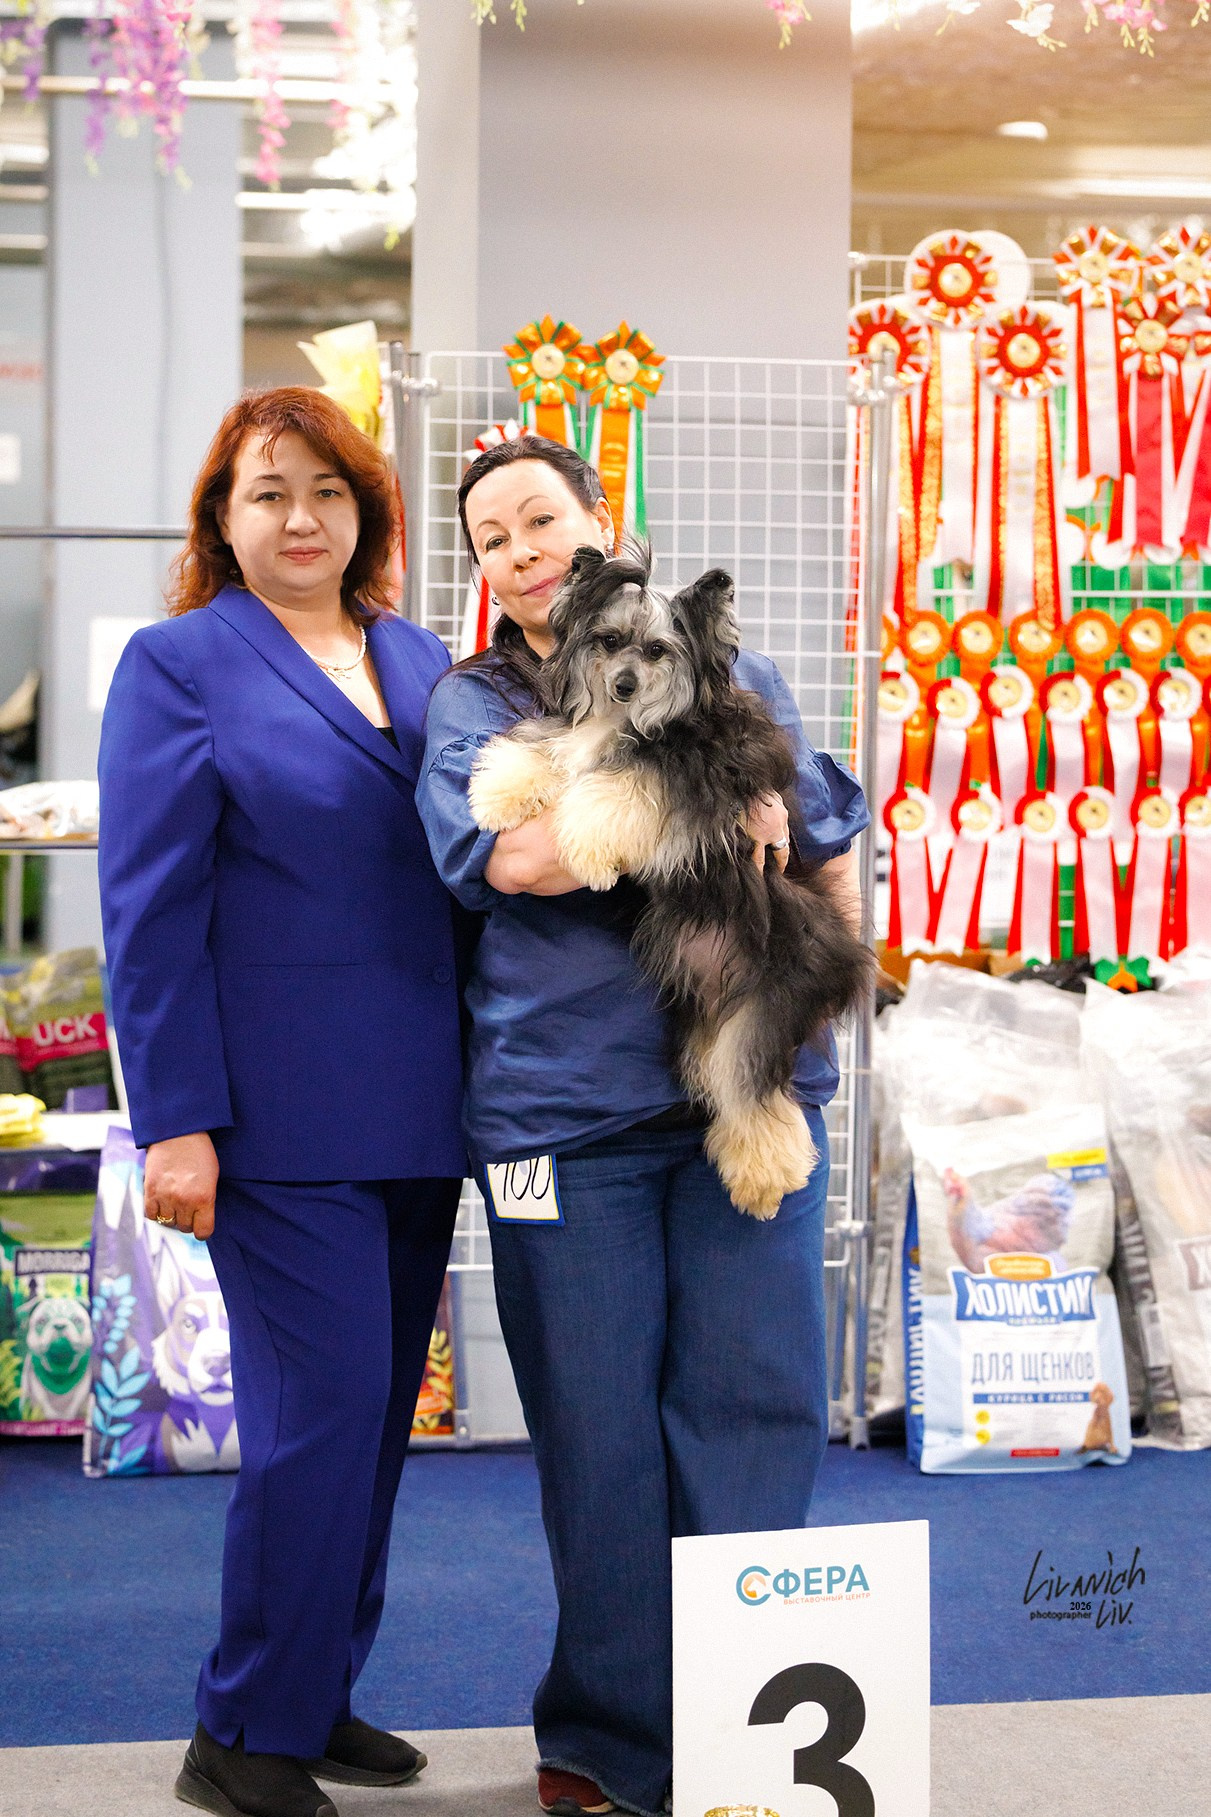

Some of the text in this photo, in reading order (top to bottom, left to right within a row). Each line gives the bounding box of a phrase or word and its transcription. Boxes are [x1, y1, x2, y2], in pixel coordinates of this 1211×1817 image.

[964, 1276, 1092, 1317] ХОЛИСТИК
[972, 1352, 1095, 1384] ДЛЯ ЩЕНКОВ
[736, 1564, 870, 1606] СФЕРА
[783, 1592, 871, 1605] ВЫСТАВОЧНЫЙ ЦЕНТР
[747, 1662, 875, 1817] 3
